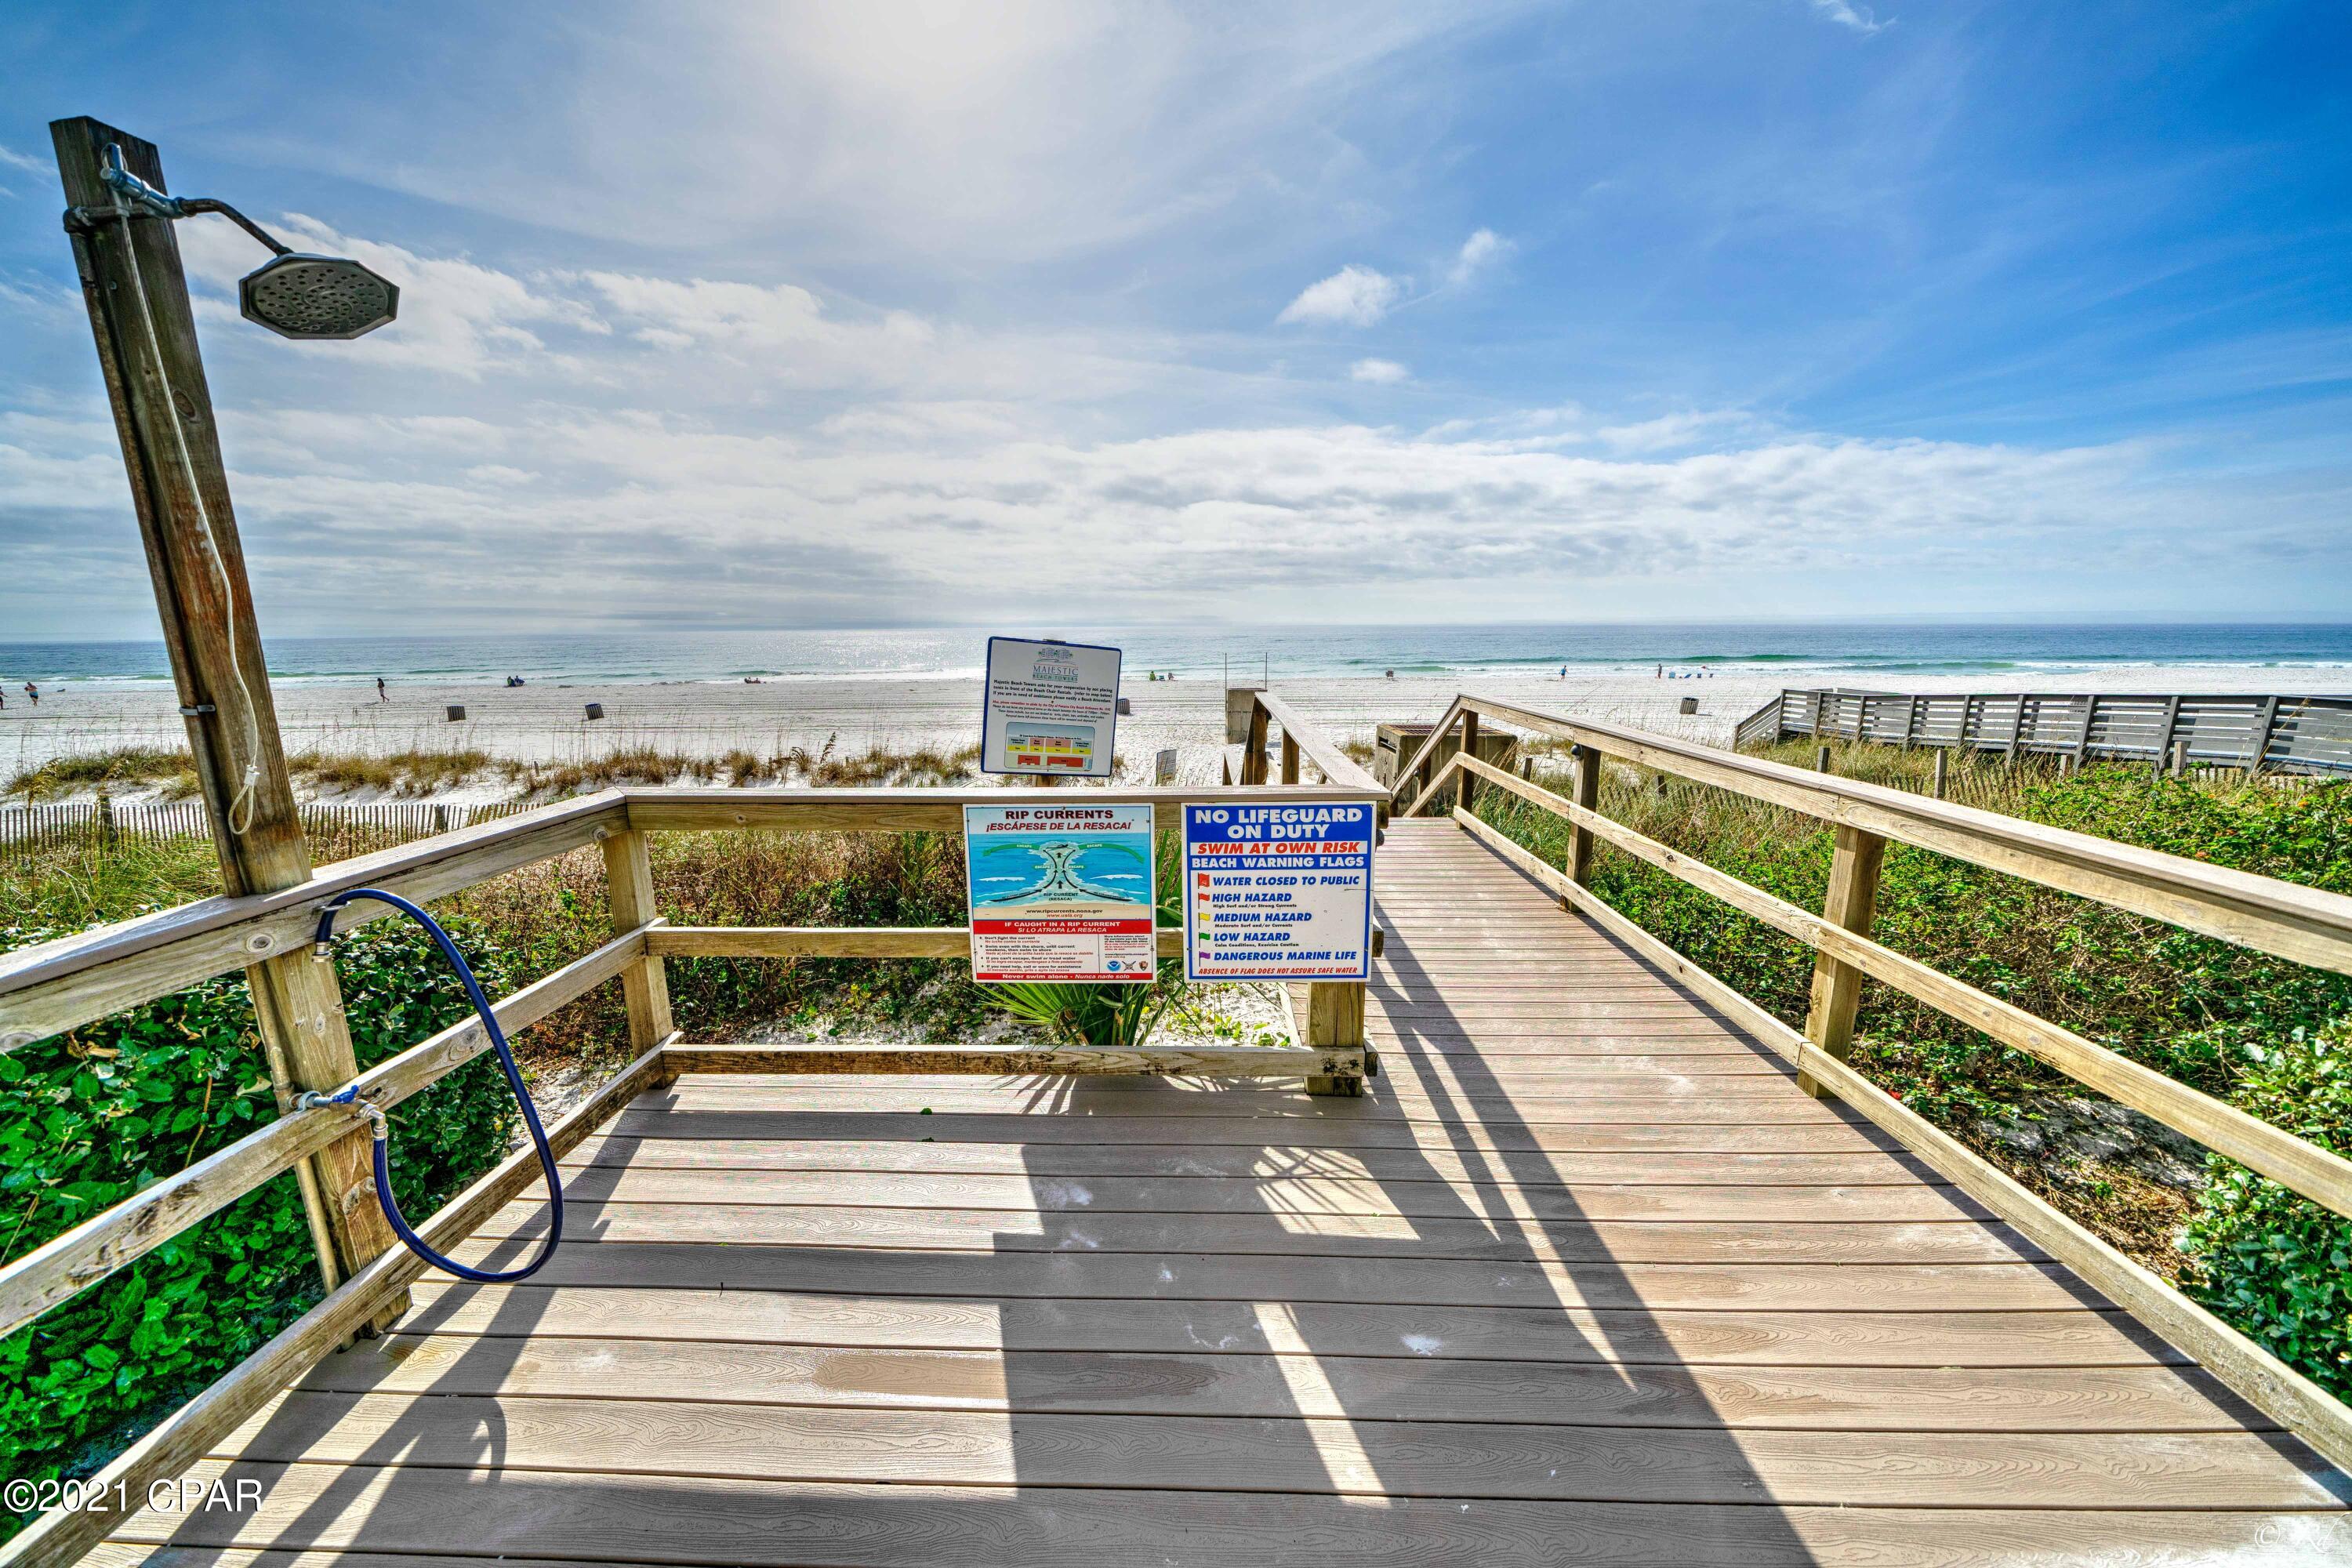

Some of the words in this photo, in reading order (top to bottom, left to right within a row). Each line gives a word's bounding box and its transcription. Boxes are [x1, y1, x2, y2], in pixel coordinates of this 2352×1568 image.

[1034, 666, 1078, 675] MAJESTIC
[1005, 811, 1029, 819] RIP
[1034, 810, 1114, 819] CURRENTS
[1195, 810, 1229, 823] NO
[1238, 808, 1362, 823] LIFEGUARD
[986, 822, 1047, 832] ¡ESCÁPESE
[1227, 825, 1261, 838] ON
[1271, 824, 1330, 838] DUTY
[1198, 843, 1243, 854] SWIM
[1249, 843, 1270, 854] AT
[1275, 842, 1320, 853] OWN
[1322, 842, 1360, 853] RISK
[1192, 858, 1236, 868] BEACH
[1242, 857, 1314, 867] WARNING
[1320, 857, 1364, 867] FLAGS
[1213, 877, 1251, 886] WATER
[1255, 877, 1297, 885] CLOSED
[1302, 877, 1316, 885] TO
[1320, 876, 1360, 885] PUBLIC
[1212, 894, 1241, 902] HIGH
[1245, 893, 1292, 902] HAZARD
[1214, 913, 1261, 922] MEDIUM
[1264, 913, 1312, 921] HAZARD
[1214, 933, 1240, 941] LOW
[1243, 933, 1290, 941] HAZARD
[1214, 952, 1283, 961] DANGEROUS
[1286, 951, 1331, 960] MARINE
[1335, 951, 1357, 960] LIFE
